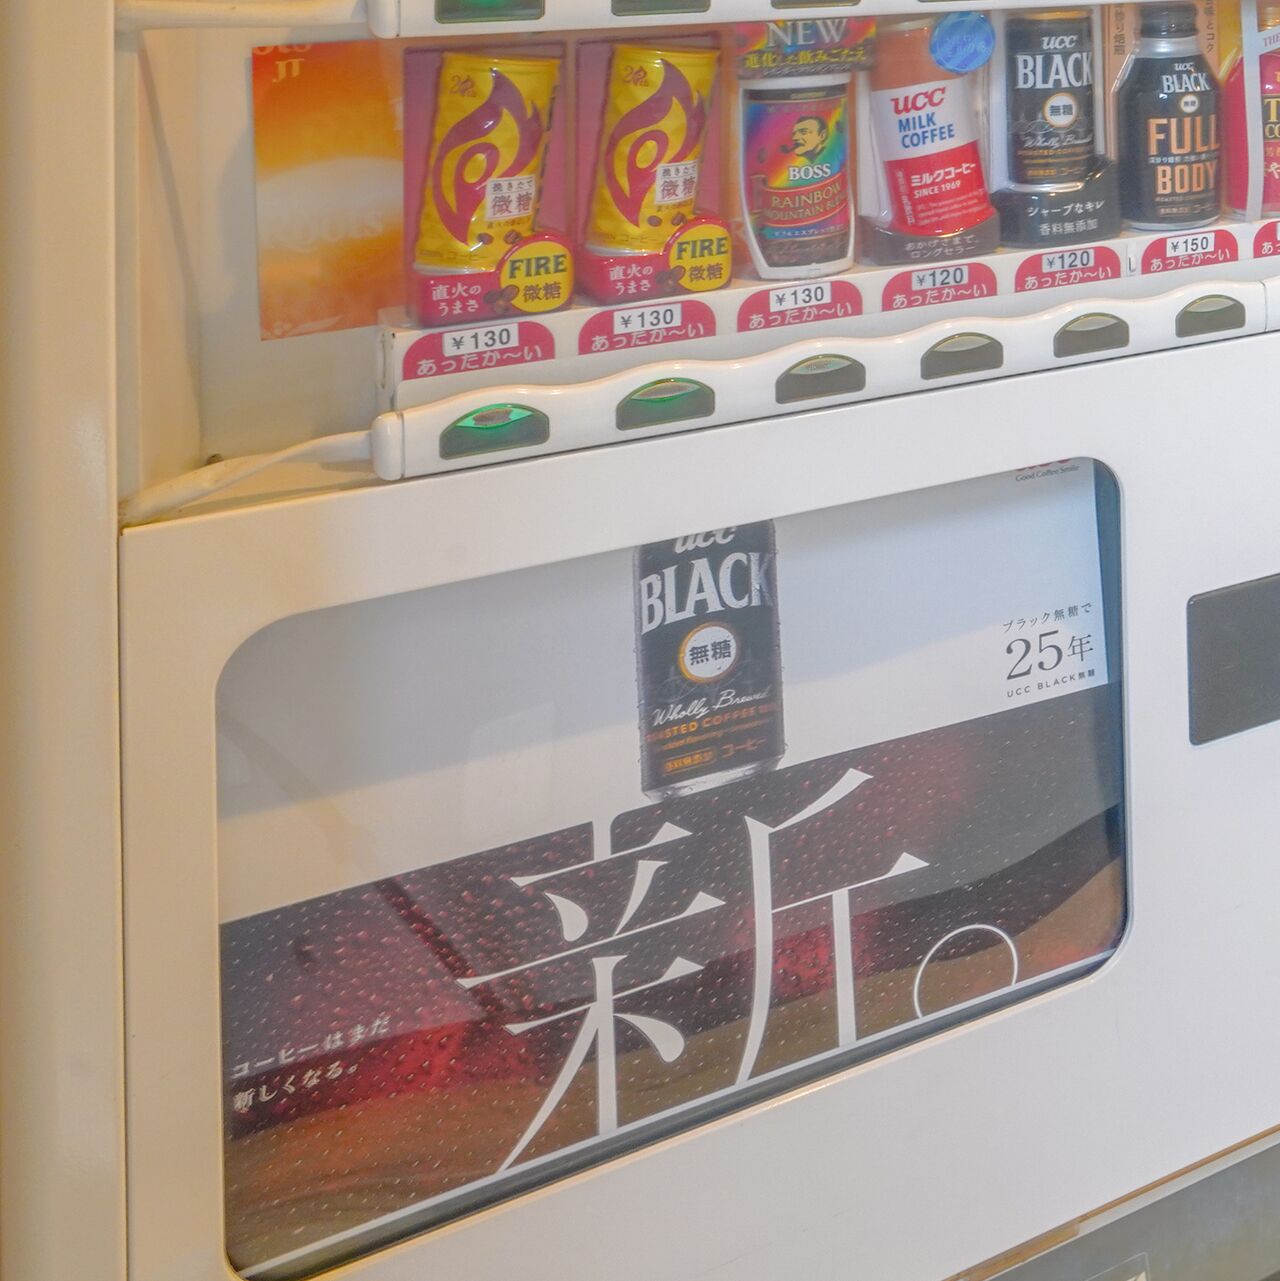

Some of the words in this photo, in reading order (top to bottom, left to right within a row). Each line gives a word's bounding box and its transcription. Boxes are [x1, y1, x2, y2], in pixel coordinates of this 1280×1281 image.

[767, 18, 848, 47] NEW
[1262, 31, 1280, 48] THE
[1015, 51, 1094, 90] BLACK
[1161, 73, 1212, 94] BLACK
[898, 112, 936, 133] MILK
[1148, 115, 1220, 156] FULL
[901, 123, 955, 149] COFFEE
[788, 163, 832, 182] BOSS
[911, 161, 976, 187] ミルクコーヒー
[1156, 163, 1217, 195] BODY
[771, 181, 842, 209] RAINBOW
[913, 184, 940, 199] SINCE
[674, 234, 729, 260] FIRE
[508, 253, 567, 279] FIRE
[688, 263, 723, 282] 微糖
[1046, 251, 1090, 270] ¥120
[916, 268, 964, 287] ¥120
[521, 282, 562, 302] 微糖
[640, 550, 775, 635] BLACK
[1002, 602, 1093, 633] ブラック無糖で
[689, 639, 732, 665] 無糖
[1006, 629, 1094, 681] 25年
[1007, 684, 1032, 698] UCC
[231, 1016, 391, 1080] コーヒーはまだ
[232, 1060, 359, 1114] 新しくなる。
